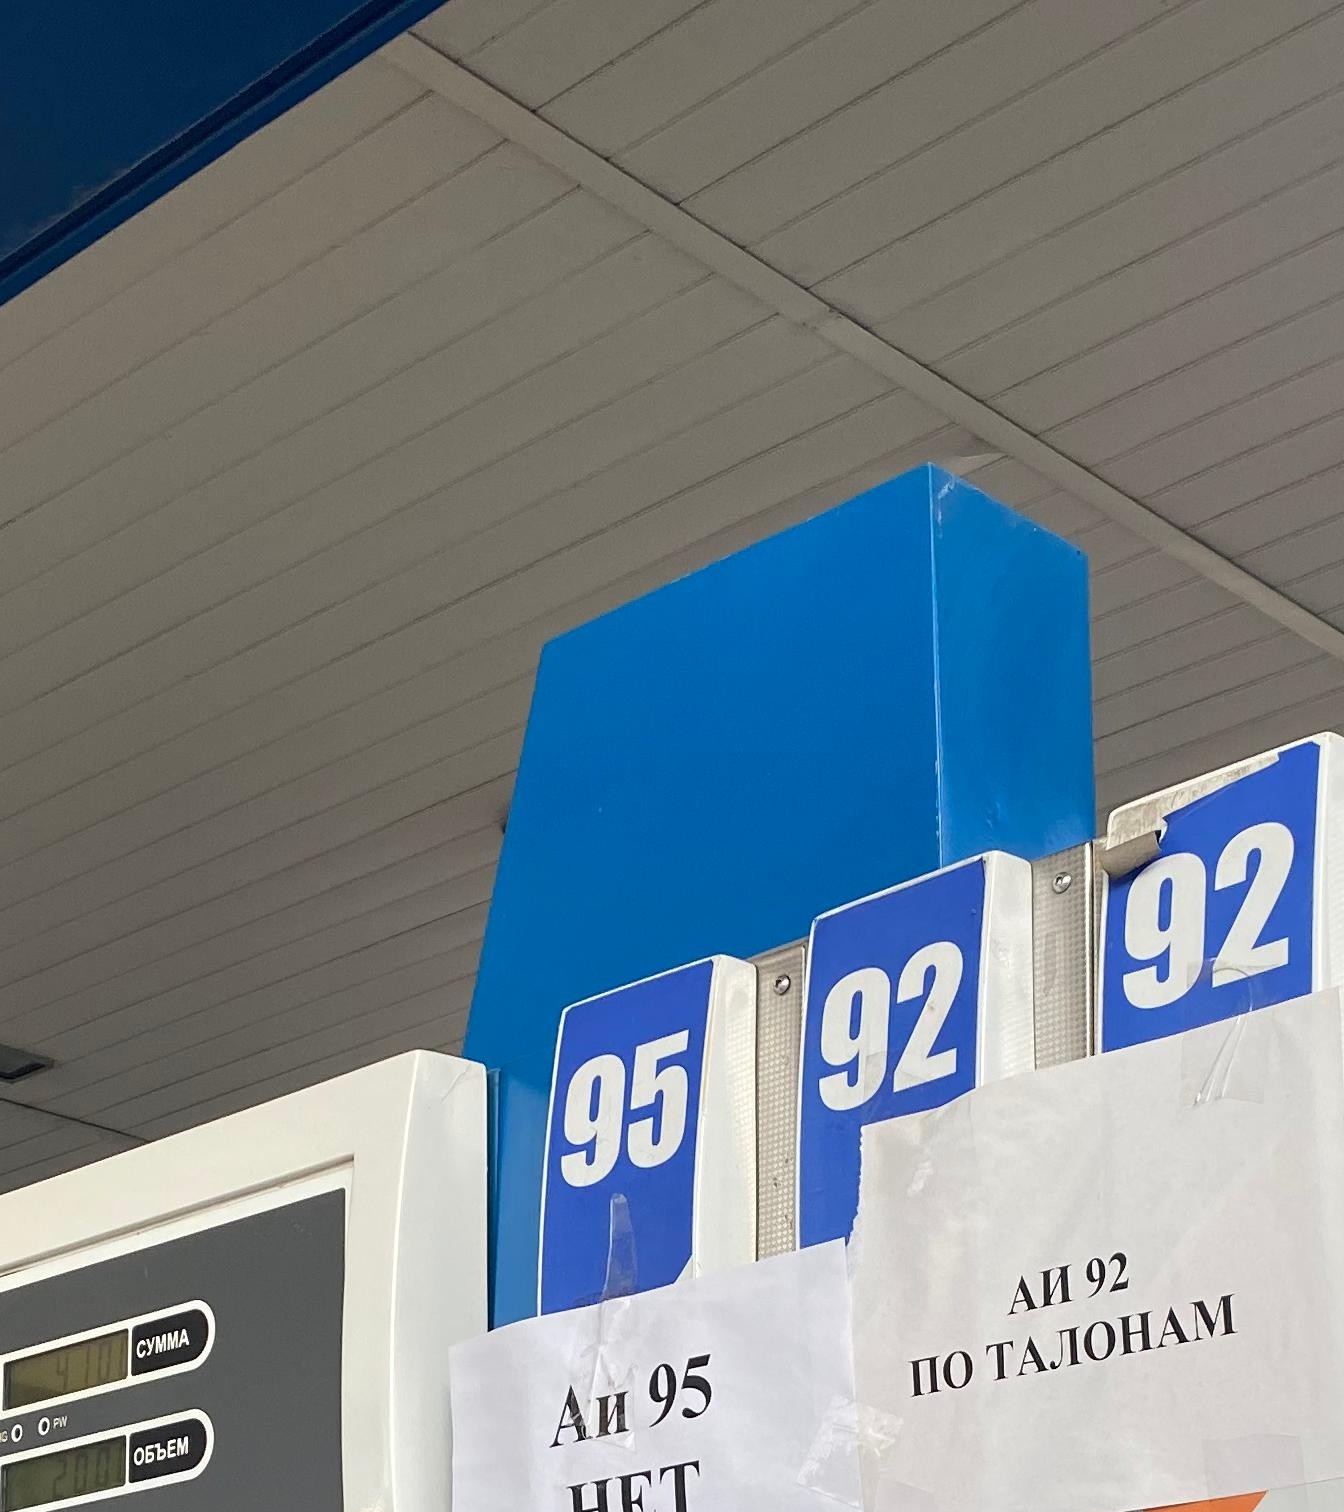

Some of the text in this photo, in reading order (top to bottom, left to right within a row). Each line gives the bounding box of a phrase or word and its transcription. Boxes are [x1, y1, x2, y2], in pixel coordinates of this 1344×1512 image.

[1122, 821, 1297, 1010] 92
[818, 940, 964, 1112] 92
[561, 1029, 692, 1188] 95
[1006, 1252, 1131, 1317] АИ 92
[136, 1327, 190, 1360] СУММА
[908, 1294, 1239, 1398] ПО ТАЛОНАМ
[133, 1434, 190, 1467] ОБЪЕМ
[549, 1353, 714, 1449] Аи 95
